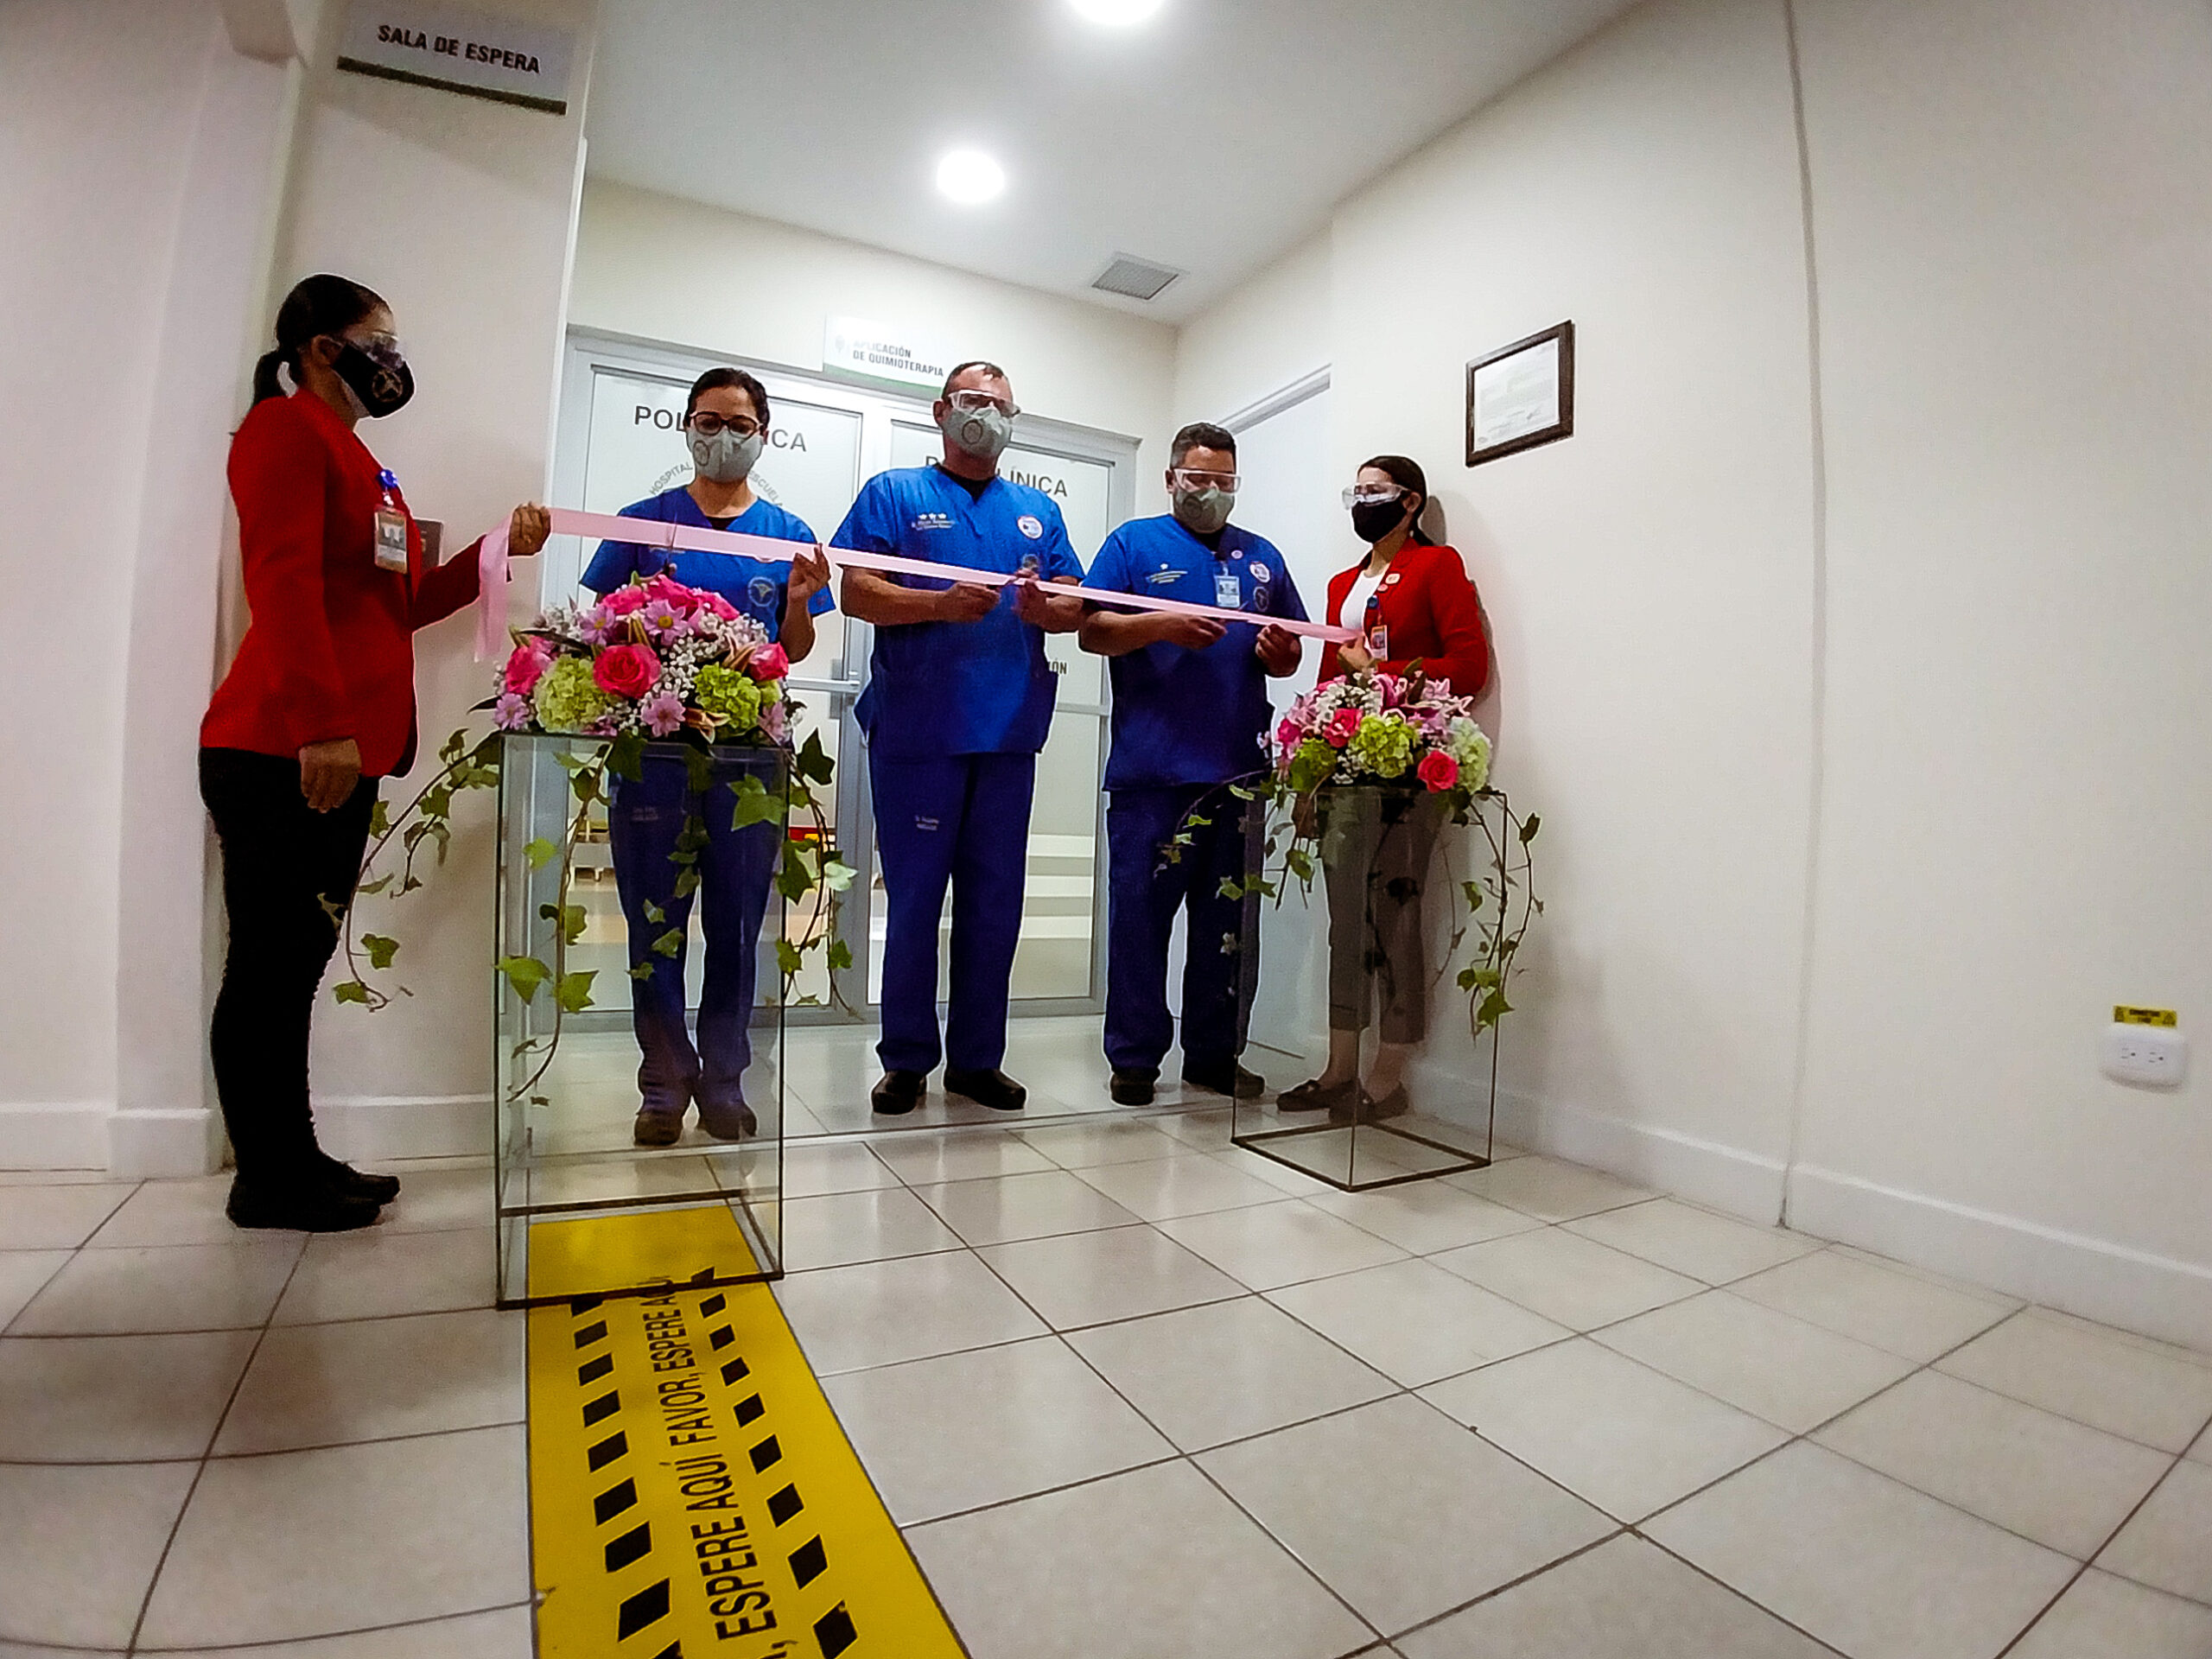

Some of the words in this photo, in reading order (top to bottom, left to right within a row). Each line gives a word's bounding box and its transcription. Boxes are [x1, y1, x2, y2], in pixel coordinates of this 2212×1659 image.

[378, 24, 428, 50] SALA
[434, 35, 461, 57] DE
[465, 42, 541, 74] ESPERA
[852, 349, 866, 361] DE
[868, 353, 944, 378] QUIMIOTERAPIA
[853, 340, 912, 359] APLICACIÓN
[649, 461, 694, 495] HOSPITAL
[642, 1308, 696, 1373] ESPERE
[658, 1371, 718, 1446] FAVOR,
[658, 1453, 740, 1511] AQUÍ
[690, 1516, 778, 1641] ESPERE
